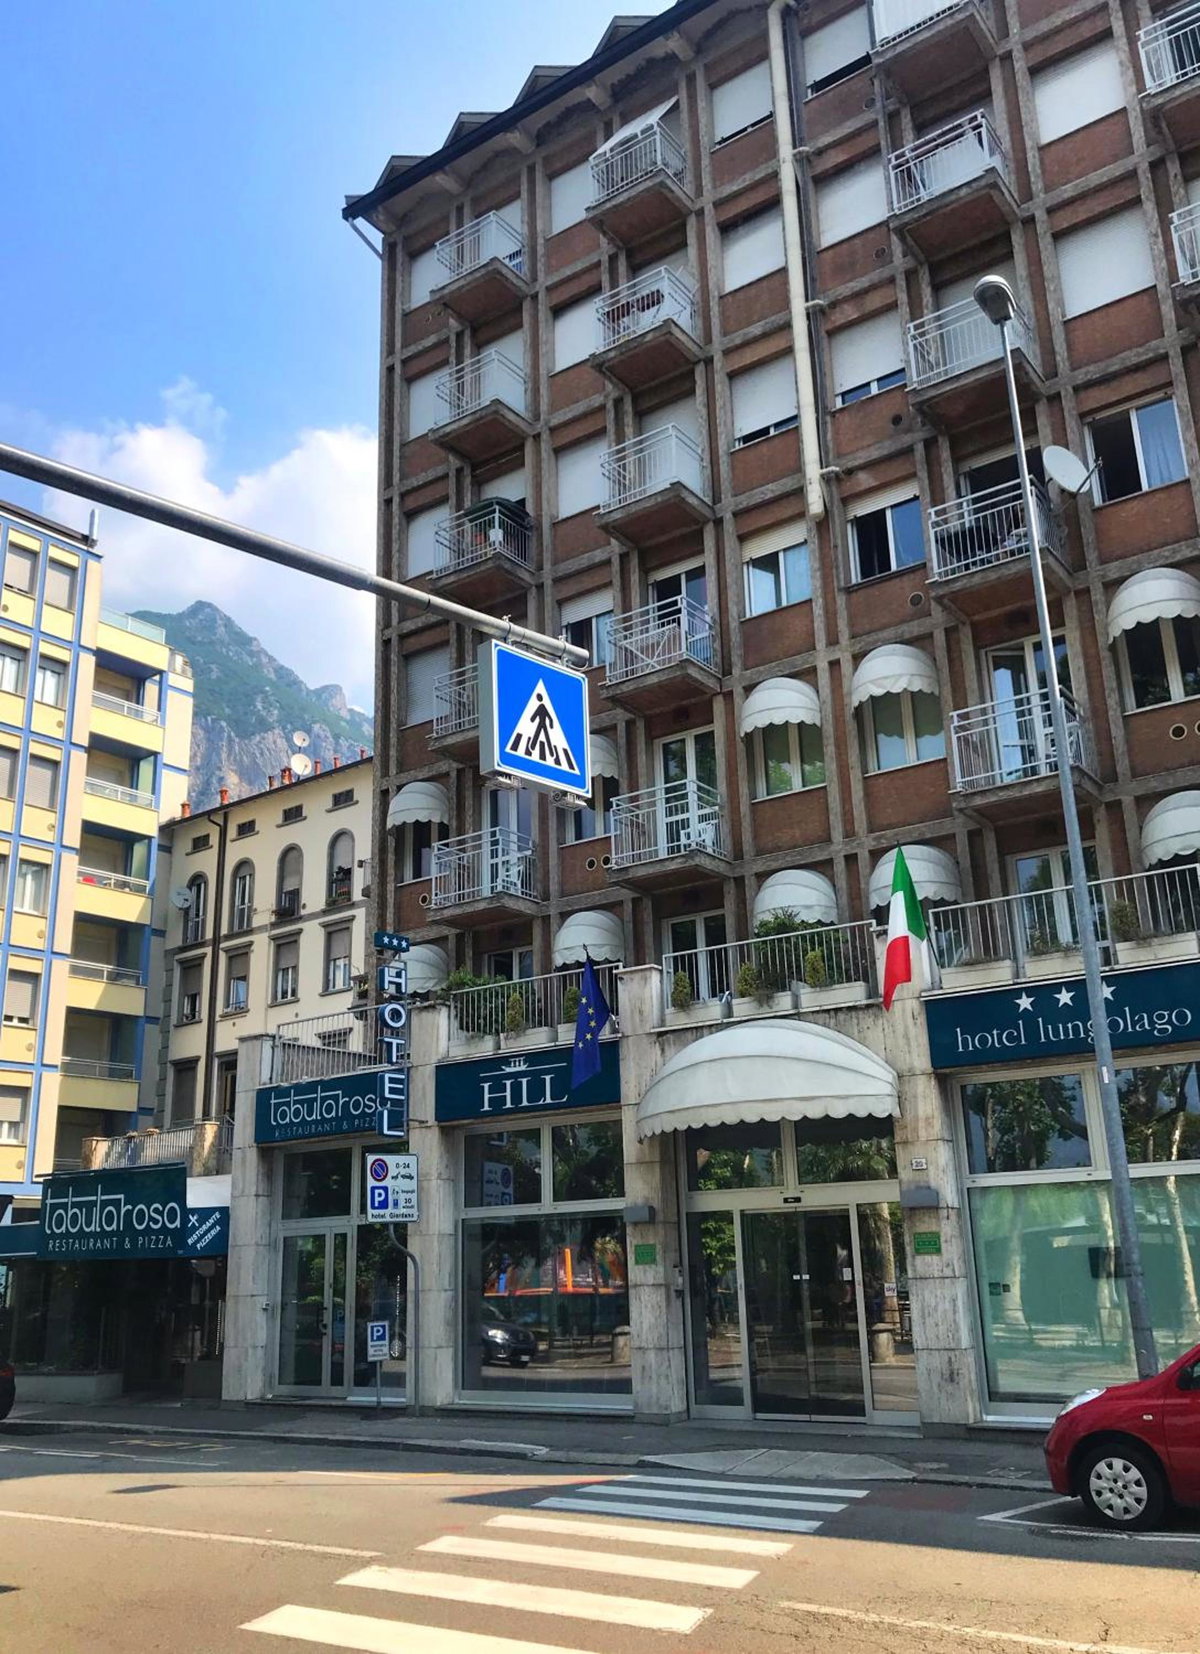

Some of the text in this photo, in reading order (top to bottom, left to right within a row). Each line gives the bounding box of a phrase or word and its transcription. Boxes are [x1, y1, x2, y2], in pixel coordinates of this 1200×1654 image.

[955, 1019, 1027, 1052] hotel
[383, 966, 406, 1136] HOTEL
[479, 1074, 569, 1112] HLL
[275, 1116, 377, 1138] RESTAURANT & PIZZ
[44, 1184, 181, 1235] tabularosa
[374, 1189, 386, 1207] P
[48, 1235, 173, 1251] RESTAURANT & PIZZA
[187, 1211, 221, 1246] RISTORANTE
[196, 1225, 221, 1250] PIZZERIA
[373, 1326, 384, 1340] P
